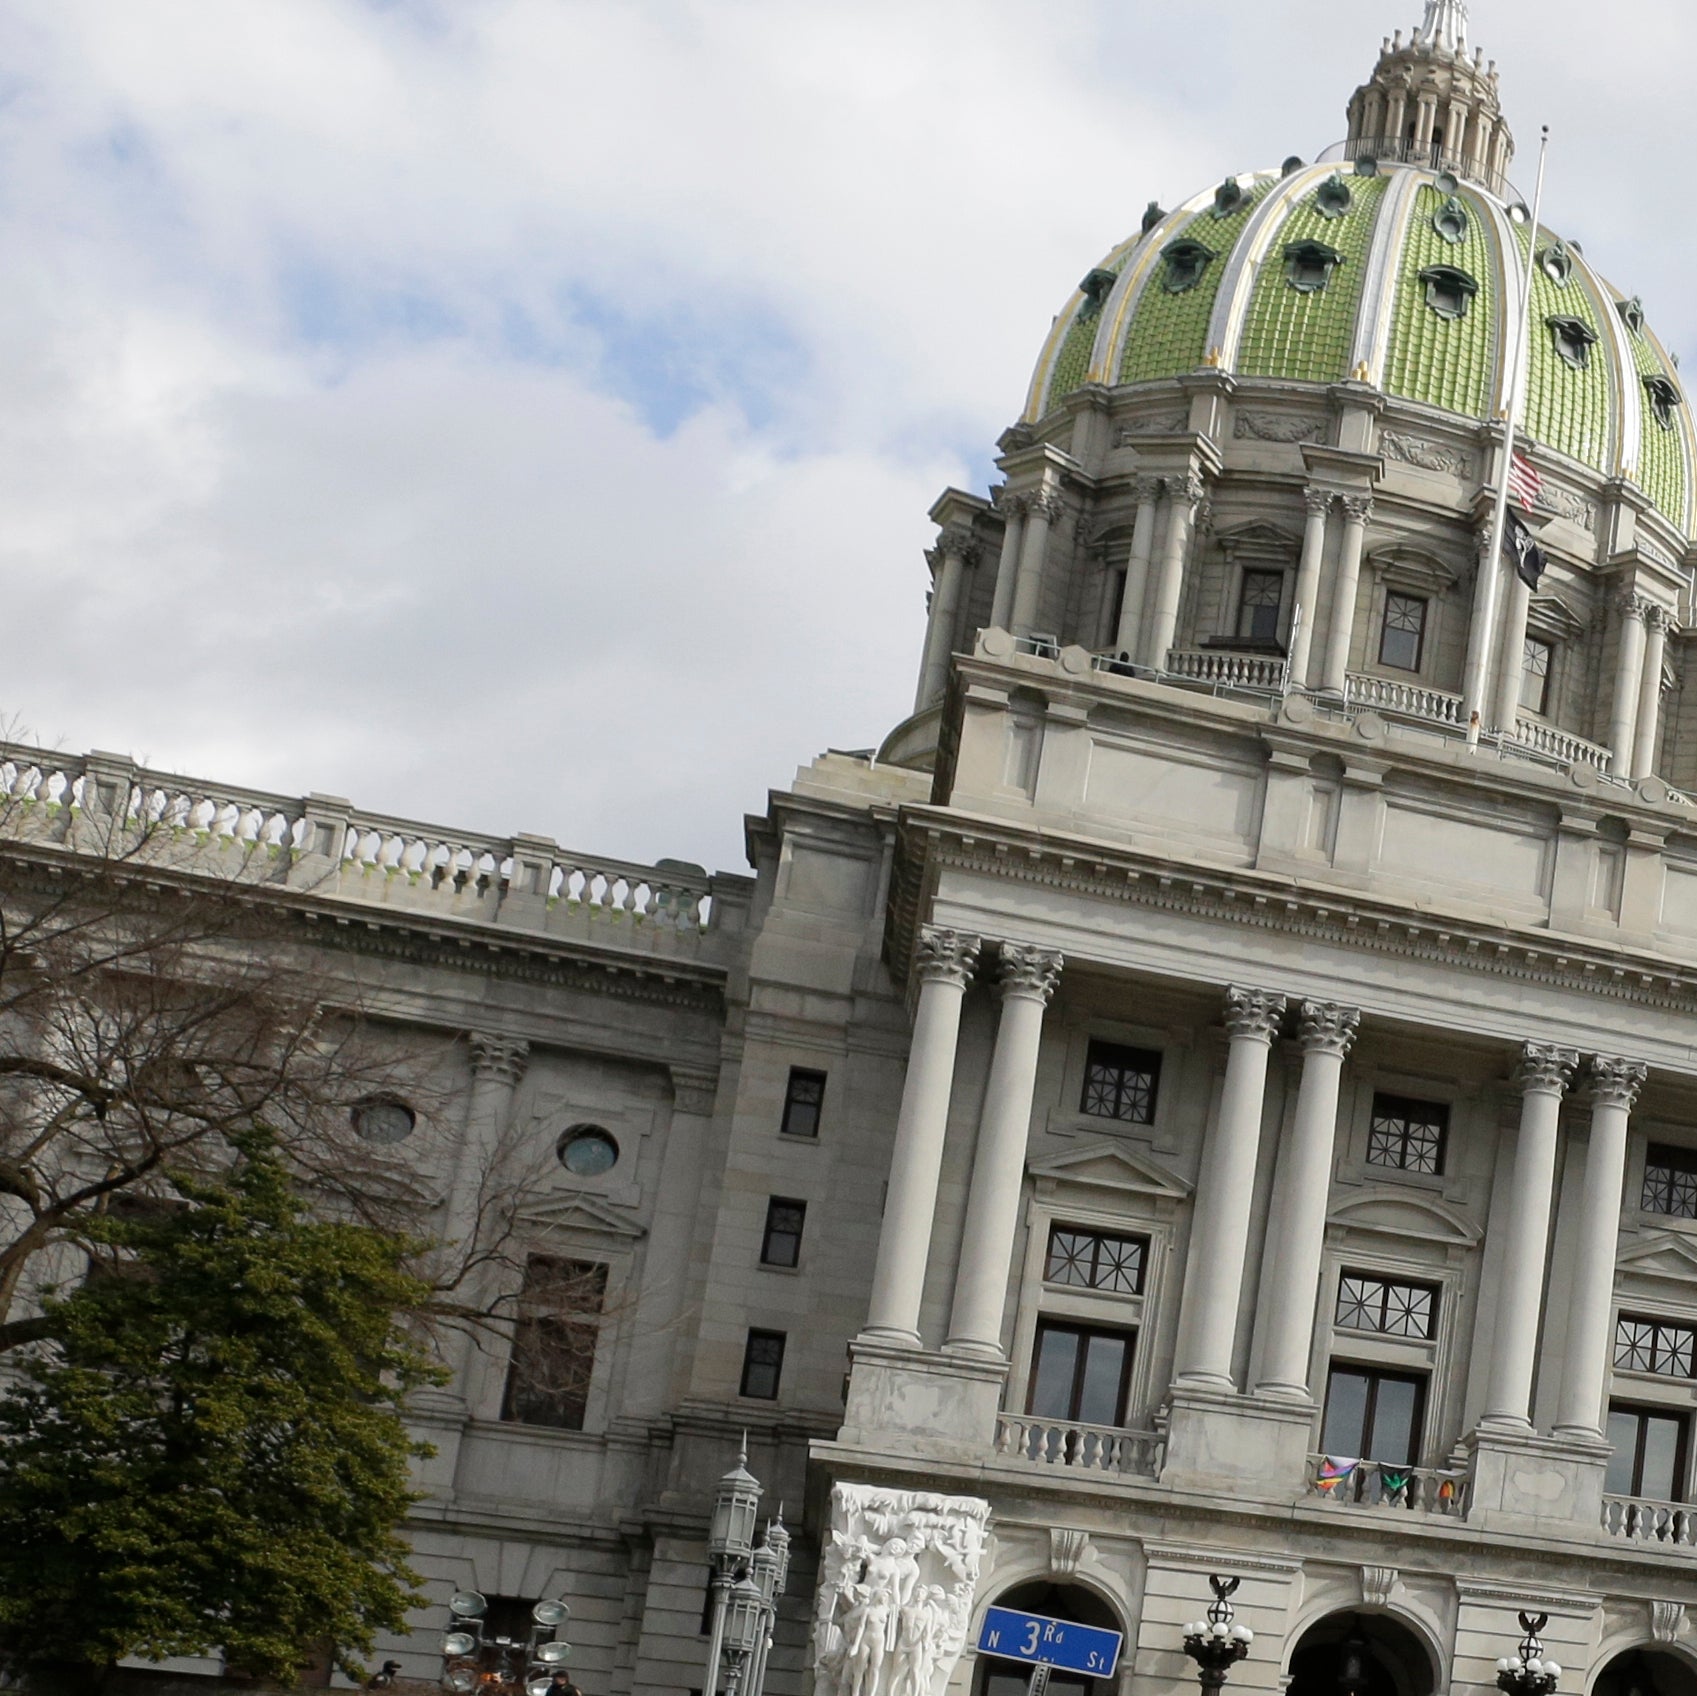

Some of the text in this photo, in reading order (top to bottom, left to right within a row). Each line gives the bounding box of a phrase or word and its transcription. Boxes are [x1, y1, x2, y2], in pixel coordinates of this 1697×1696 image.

[987, 1621, 1105, 1670] N 3Rd St
